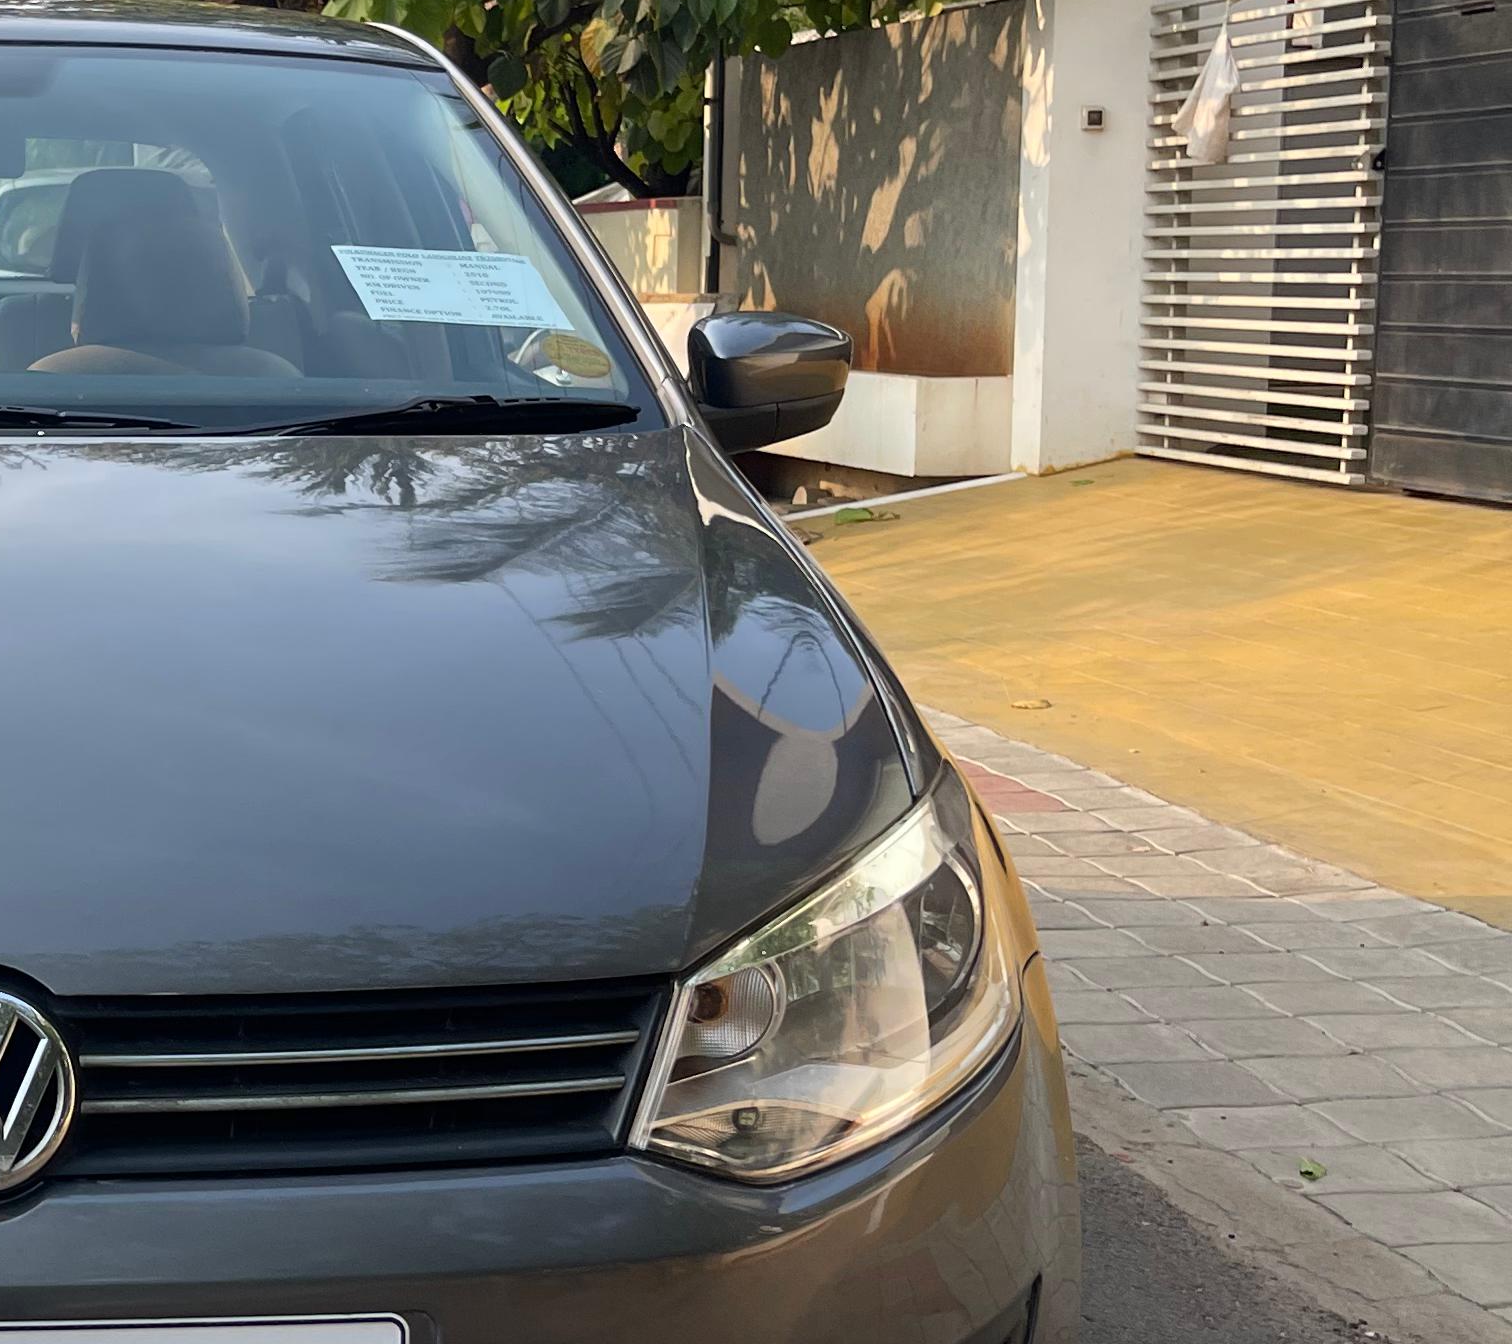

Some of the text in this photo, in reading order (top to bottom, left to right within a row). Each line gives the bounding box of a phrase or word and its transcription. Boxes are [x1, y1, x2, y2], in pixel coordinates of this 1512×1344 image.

[351, 256, 423, 267] TRANSMISSION
[459, 262, 502, 271] MANUAL
[370, 289, 519, 305] FUEL PETROL
[380, 306, 422, 315] FINANCE
[424, 308, 462, 317] OPTION
